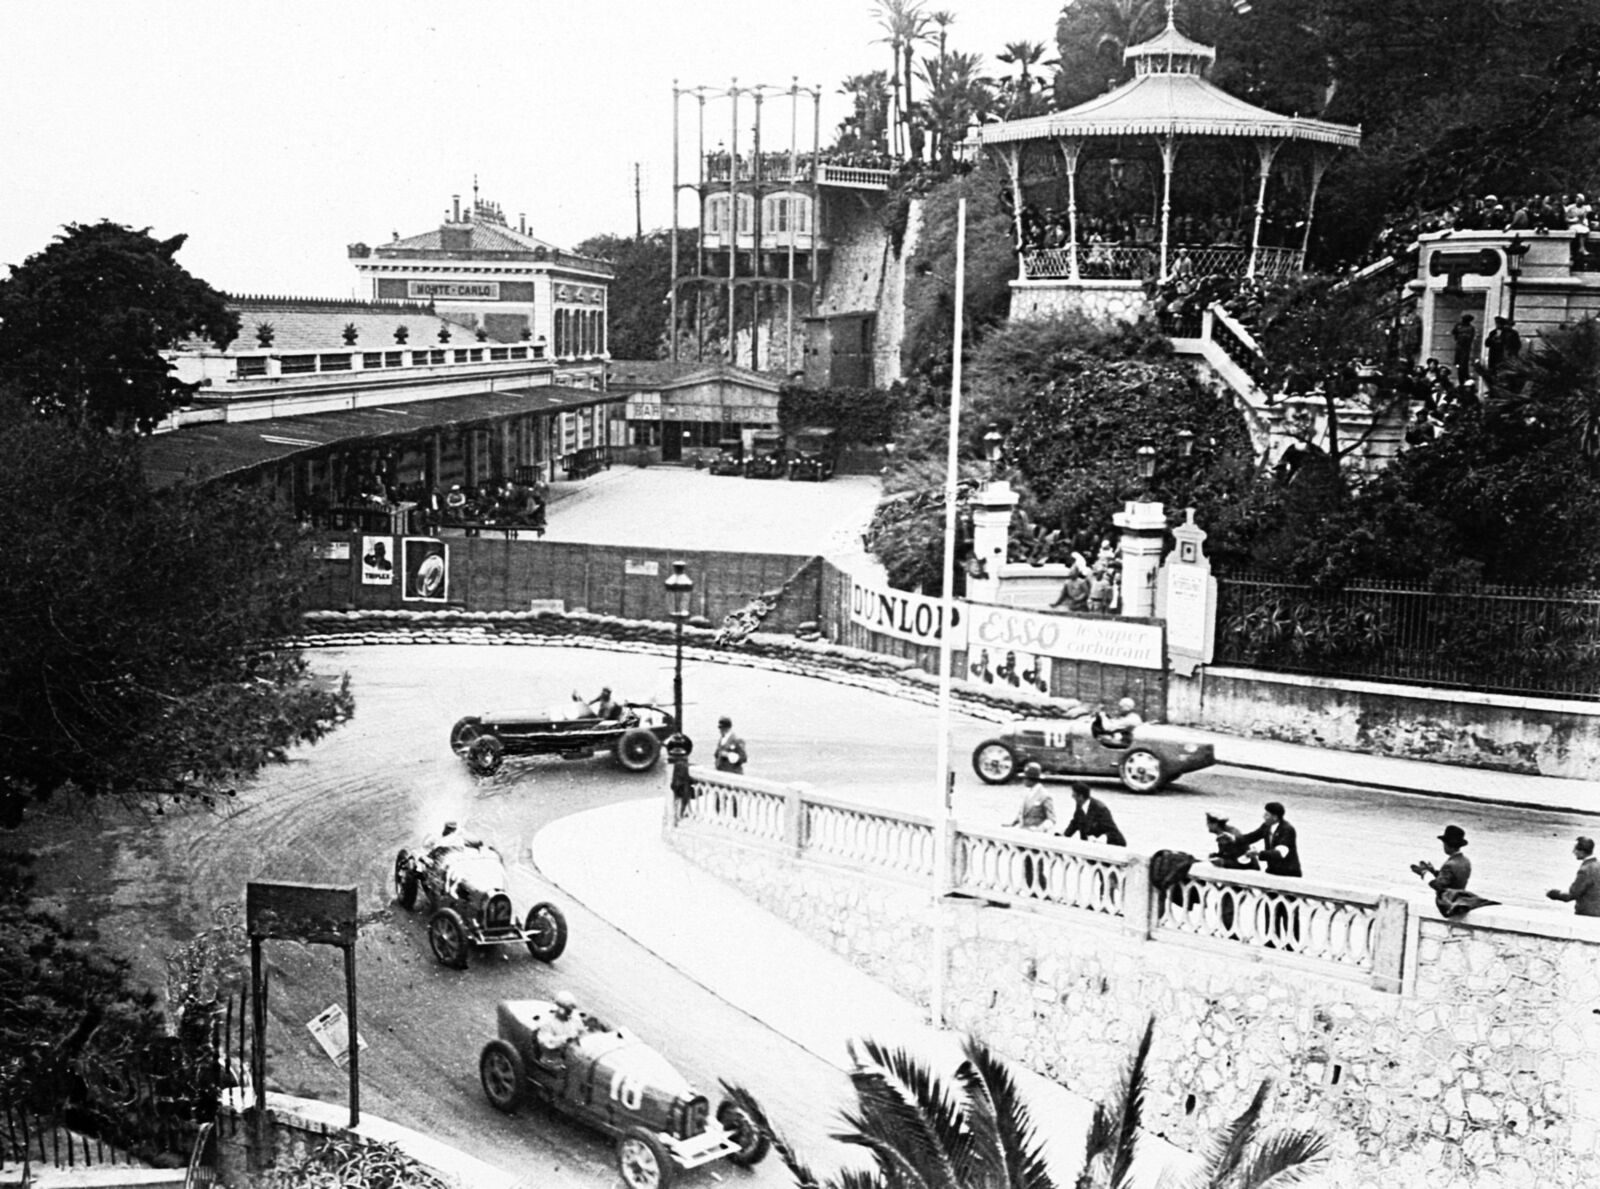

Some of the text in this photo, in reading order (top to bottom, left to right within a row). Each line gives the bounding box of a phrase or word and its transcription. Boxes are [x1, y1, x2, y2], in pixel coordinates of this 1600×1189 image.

[853, 583, 961, 640] DUNLOP
[1066, 641, 1152, 660] carburant
[489, 900, 510, 921] 12
